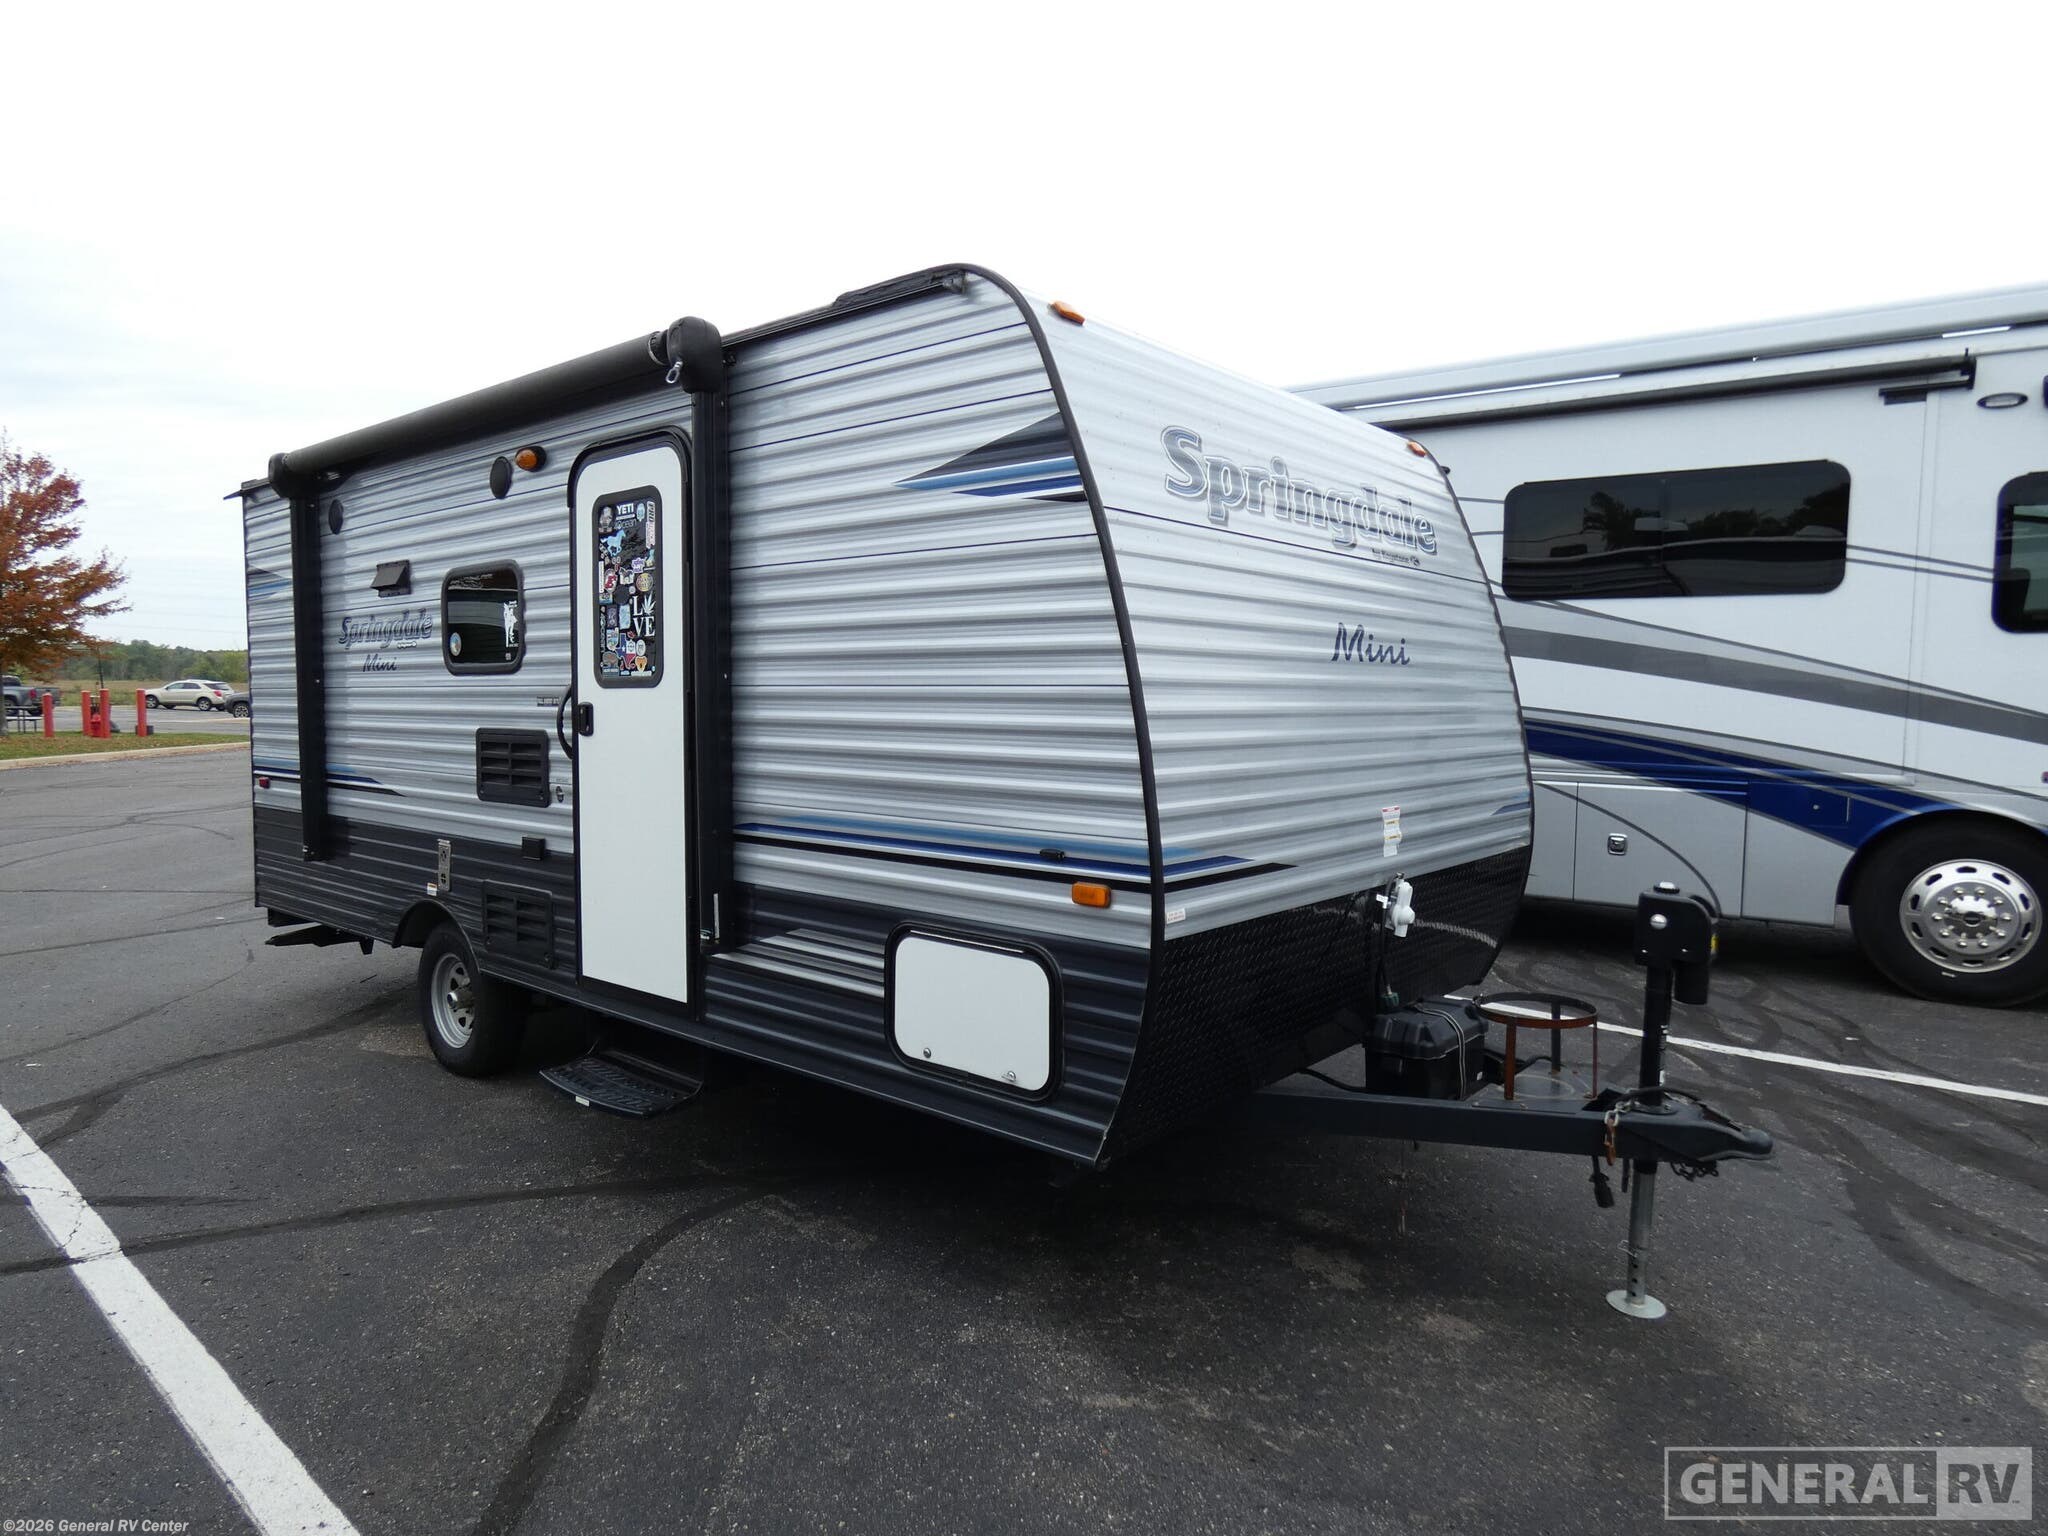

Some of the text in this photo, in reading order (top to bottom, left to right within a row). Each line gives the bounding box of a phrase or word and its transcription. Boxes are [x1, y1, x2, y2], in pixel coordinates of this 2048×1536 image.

[617, 503, 634, 515] YETI
[1161, 425, 1437, 555] Springdale
[338, 608, 433, 650] Springdale
[1331, 622, 1410, 666] Mini
[363, 653, 398, 672] Mini
